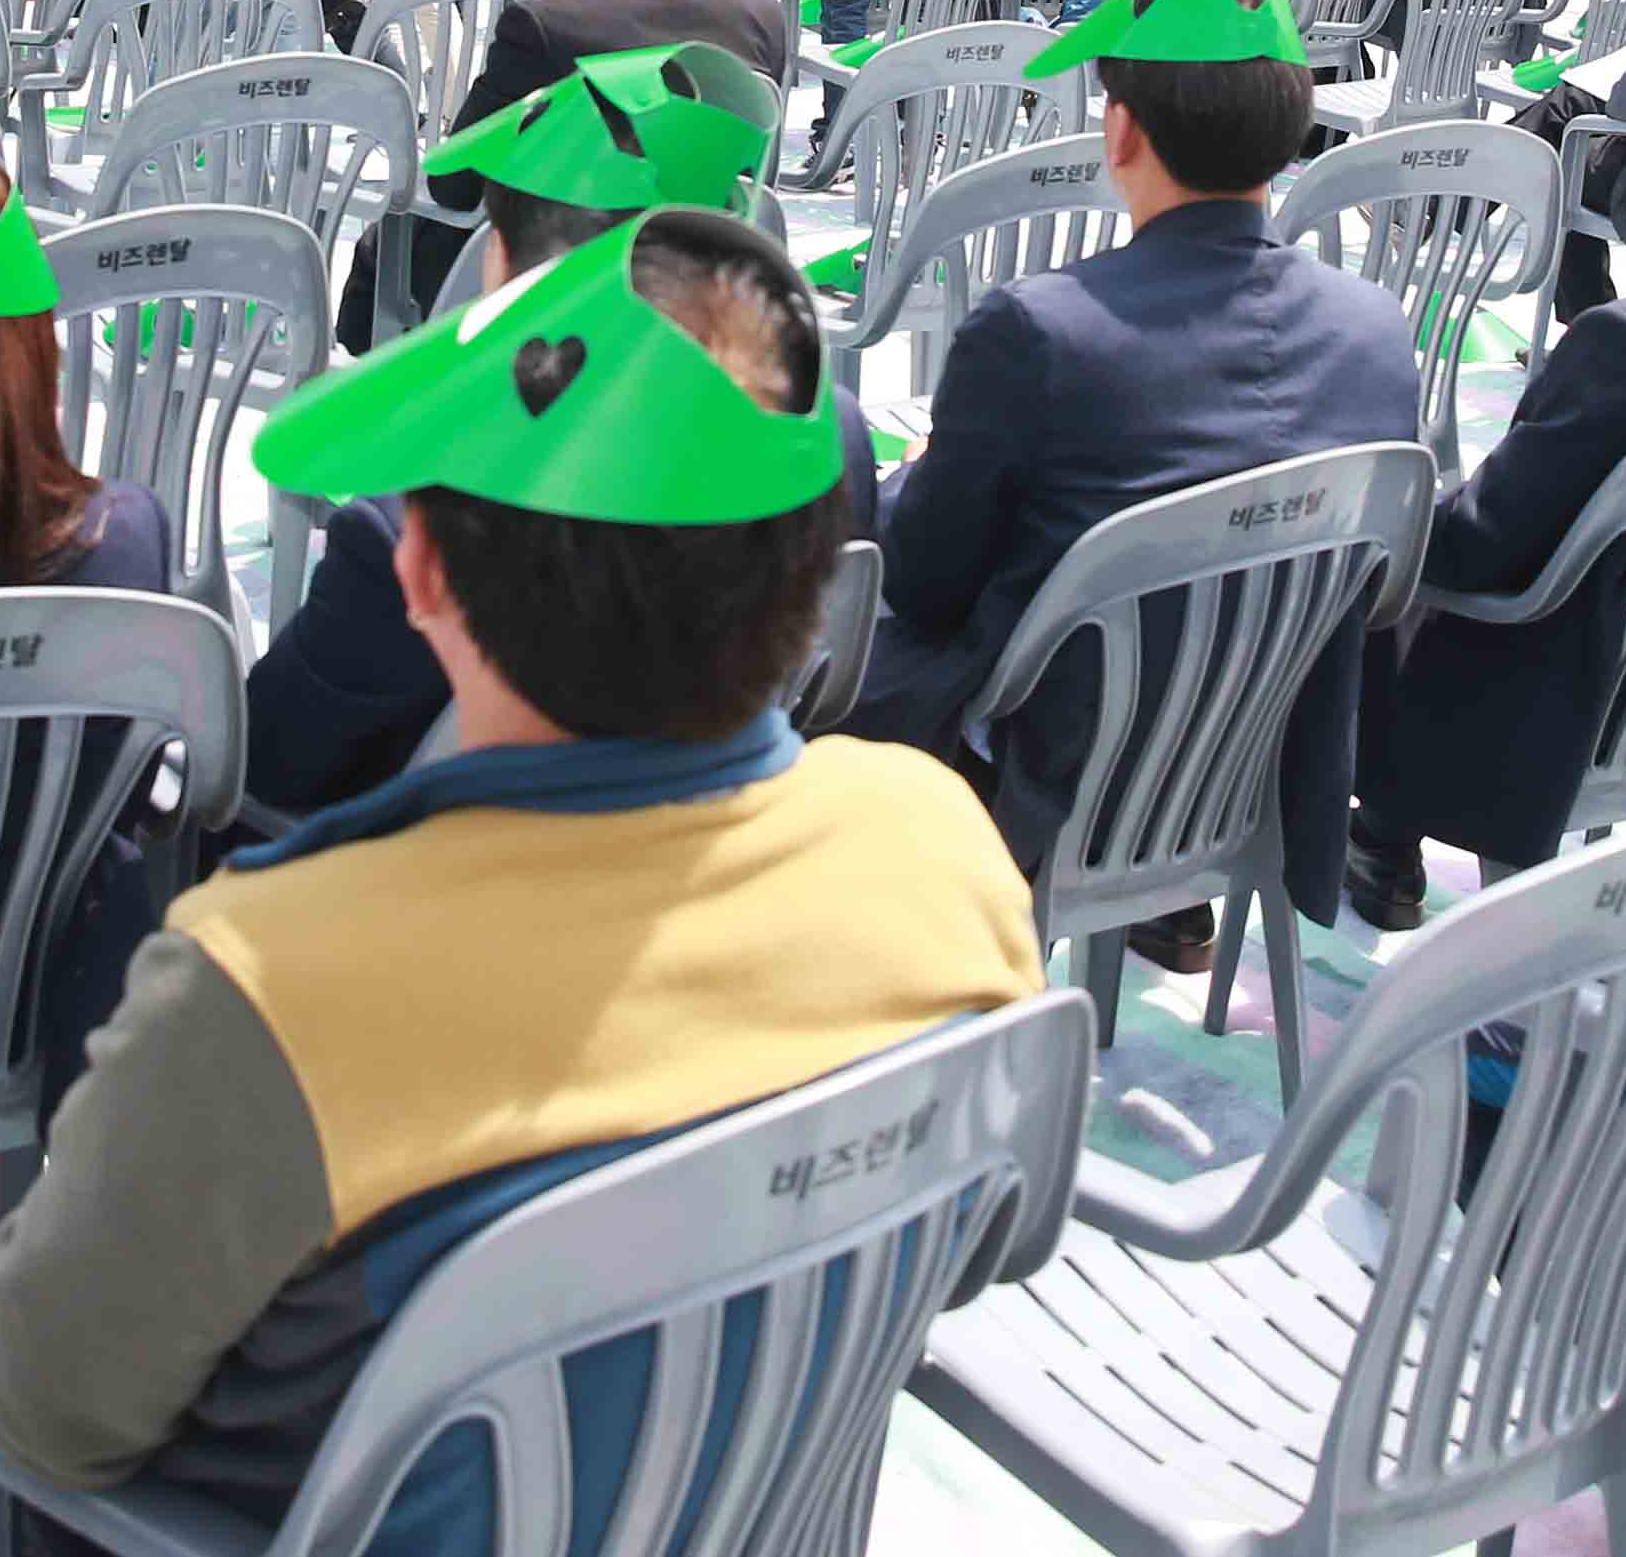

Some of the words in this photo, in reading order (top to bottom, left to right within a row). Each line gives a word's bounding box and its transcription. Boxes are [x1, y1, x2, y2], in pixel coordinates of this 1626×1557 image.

[946, 44, 1005, 62] 비즈렌탈
[238, 78, 311, 99] 비즈렌탈
[1400, 148, 1470, 171] 비즈렌탈
[1030, 163, 1101, 187] 비즈렌탈
[96, 239, 191, 274] 비즈렌탈
[1228, 487, 1327, 532] 비즈렌탈
[769, 1103, 941, 1204] 비즈렌탈
